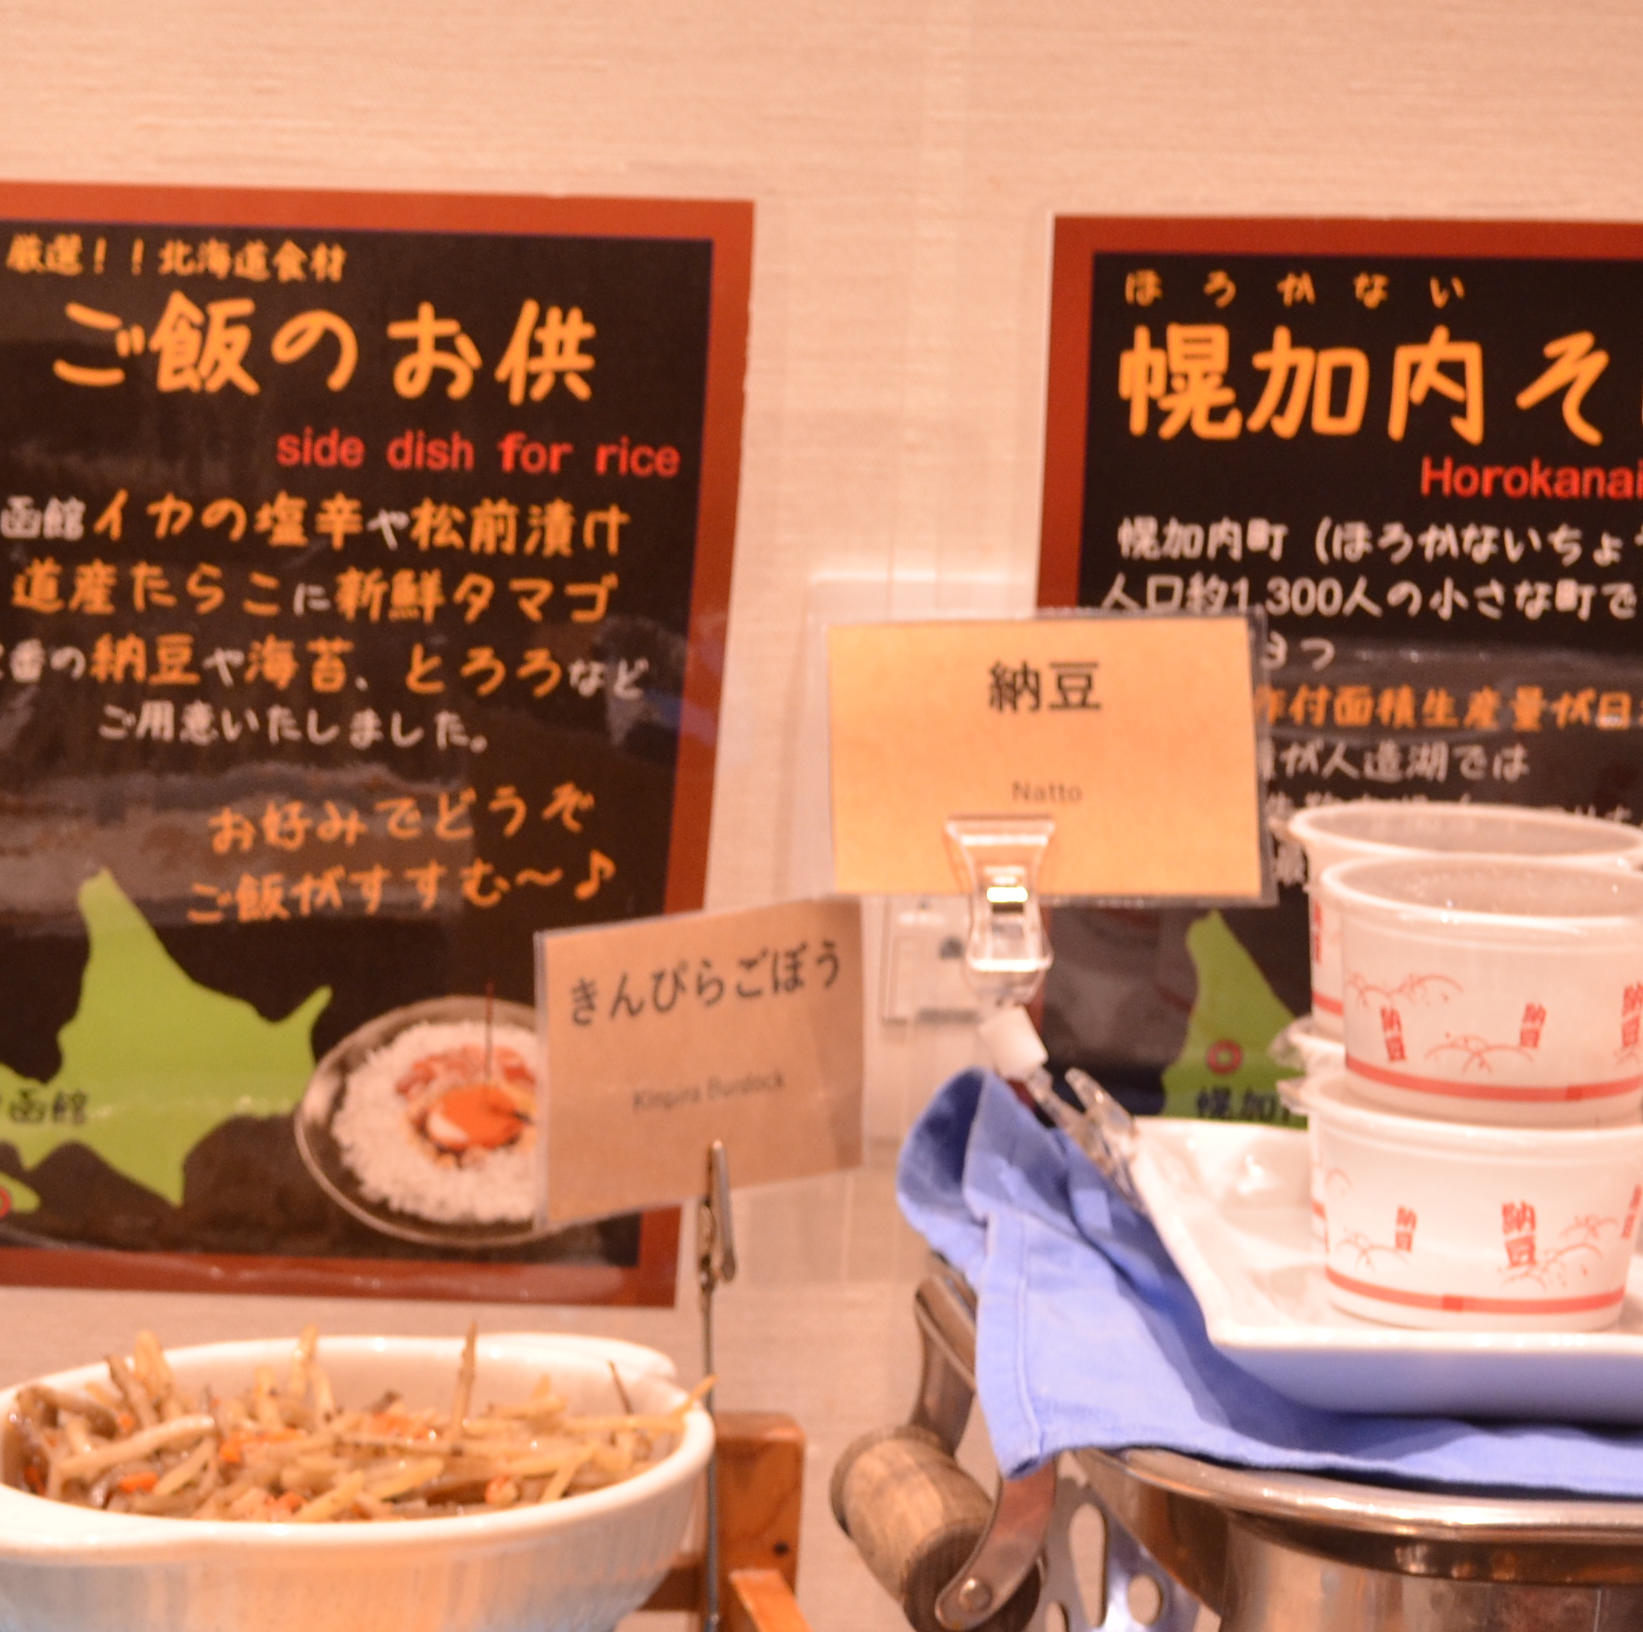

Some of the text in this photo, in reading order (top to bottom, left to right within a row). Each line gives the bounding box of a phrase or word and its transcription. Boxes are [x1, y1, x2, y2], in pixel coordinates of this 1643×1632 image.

[53, 291, 596, 405] ご飯のお供
[1118, 325, 1643, 446] 幌加内そ
[276, 430, 680, 477] side dish for rice
[0, 490, 630, 556] 函館イカの塩辛や松前漬け
[11, 559, 618, 623] 道産たらこに新鮮タマゴ
[986, 659, 1103, 714] 納豆
[98, 702, 487, 754] ご用意いたしました。
[209, 782, 596, 855] お好みでどうぞ
[1011, 779, 1083, 802] Natto
[568, 938, 843, 1028] きんぴらごぼう
[1501, 1199, 1537, 1266] 納豆
